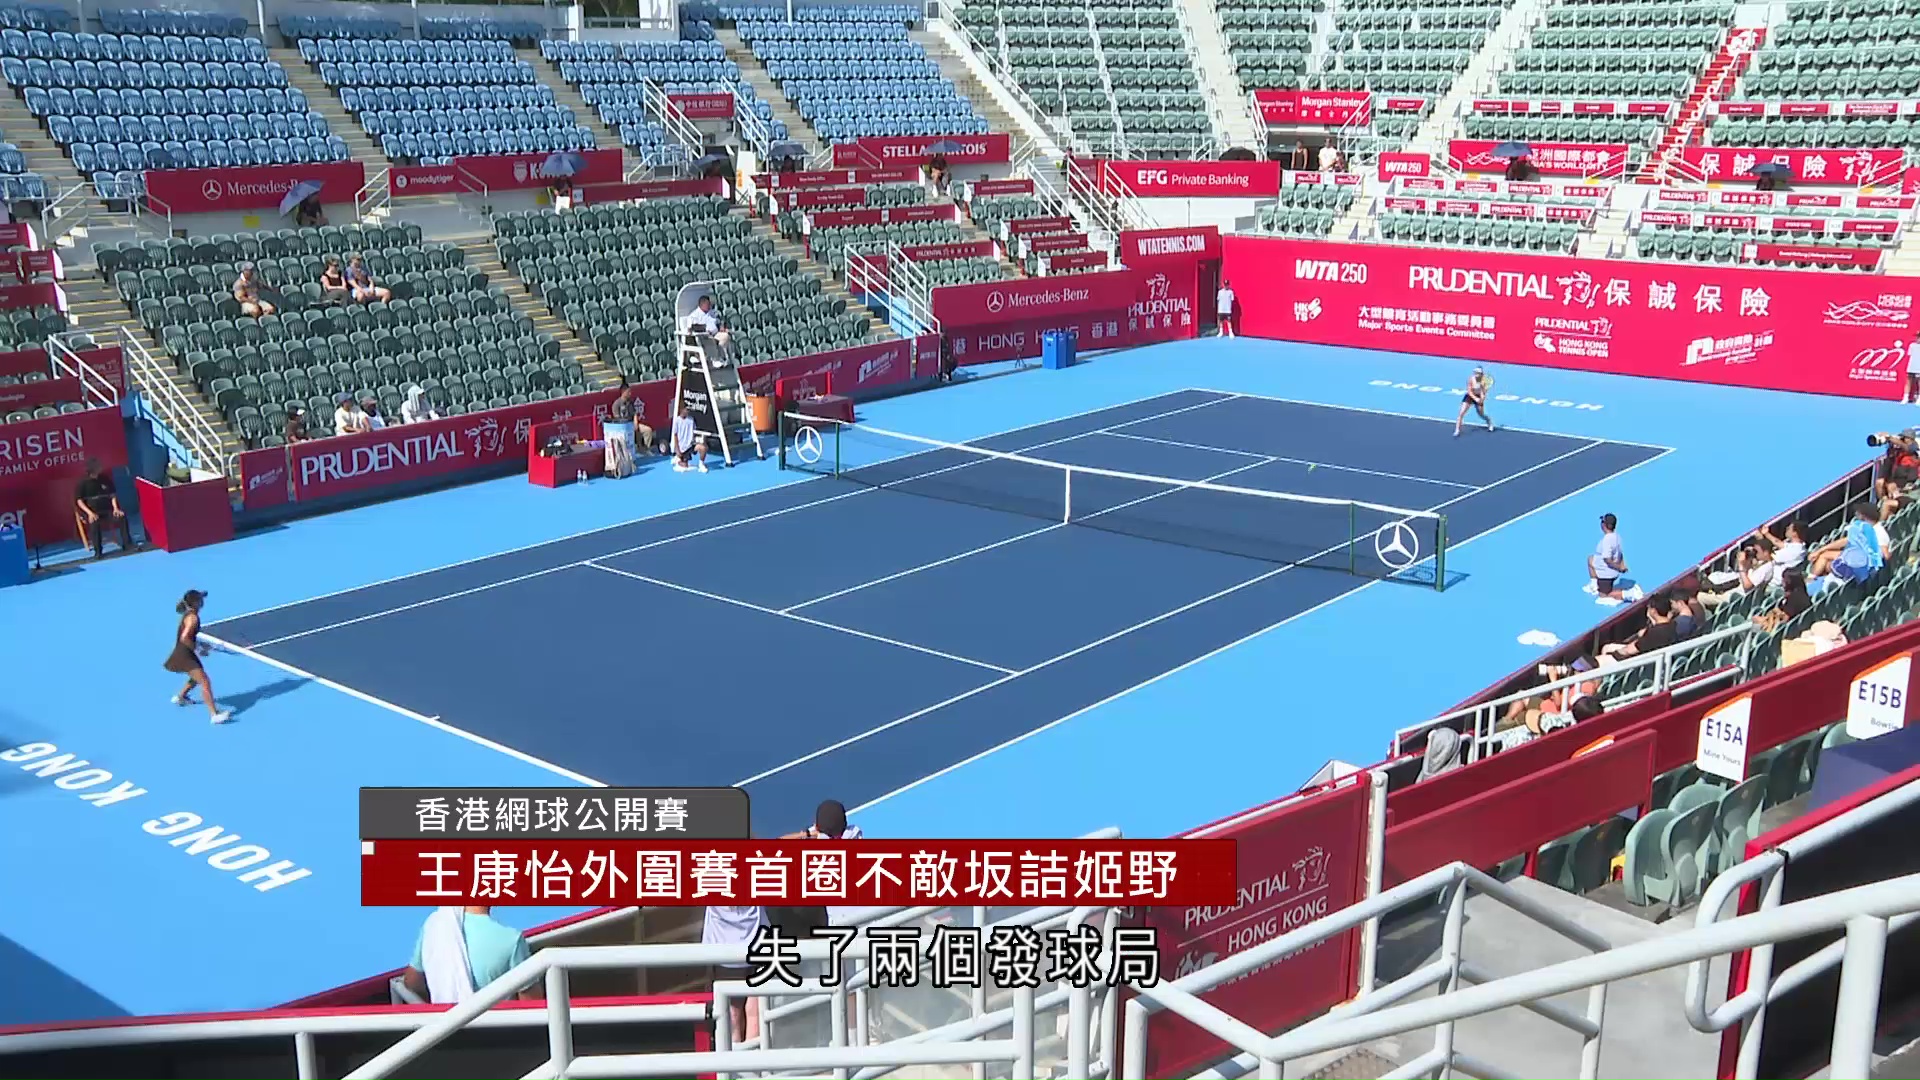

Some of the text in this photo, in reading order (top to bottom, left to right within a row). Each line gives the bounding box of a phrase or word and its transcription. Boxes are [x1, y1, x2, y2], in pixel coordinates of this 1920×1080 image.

[1302, 96, 1364, 108] Morgan Stanley
[882, 145, 928, 158] STELLA
[1408, 162, 1422, 174] 250
[227, 179, 298, 195] Mercedes-B
[410, 174, 454, 185] moodytiger
[1137, 170, 1249, 188] EFG Private Banking
[1138, 235, 1206, 256] WTATENNIS.COM
[1295, 259, 1368, 284] WTA 250
[1409, 265, 1554, 300] PRUDENTIAL
[1008, 288, 1089, 308] Mercedes-Benz
[1603, 277, 1772, 316] 保誠保險
[1128, 297, 1192, 317] PRUDENTIAL
[1358, 318, 1496, 340] Major Sports Events Committee
[1535, 316, 1590, 331] PRUDENTIAL
[978, 332, 1024, 351] HONG
[1092, 322, 1118, 338] 香港
[1559, 338, 1608, 350] HONG KONG
[684, 389, 707, 403] Morgan
[44, 451, 85, 468] OFFICE
[301, 431, 464, 486] PRUDENTIAL
[1858, 680, 1902, 709] E15B
[1706, 718, 1744, 746] E15A
[0, 742, 312, 892] HONG KONG
[1228, 896, 1328, 953] HONG KONG
